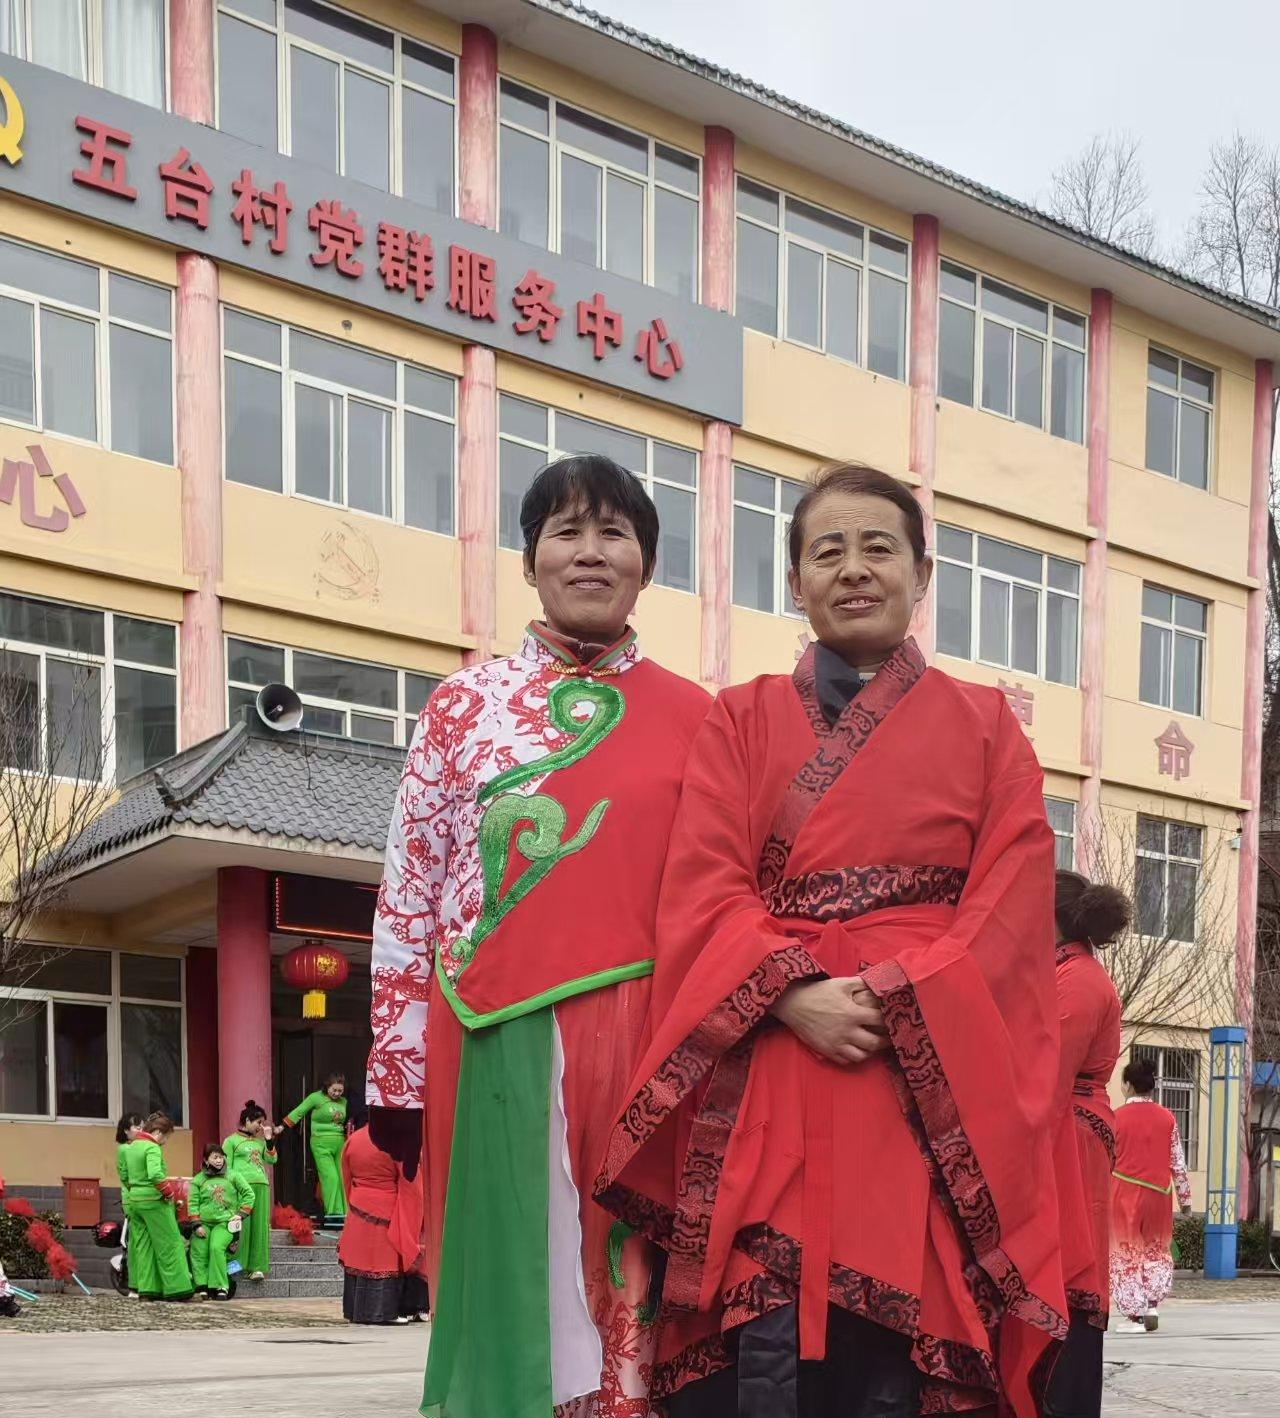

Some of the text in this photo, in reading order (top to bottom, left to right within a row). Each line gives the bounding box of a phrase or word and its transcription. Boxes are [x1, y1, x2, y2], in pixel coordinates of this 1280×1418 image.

[72, 115, 685, 380] 五台村党群服务中心
[0, 444, 87, 533] 心
